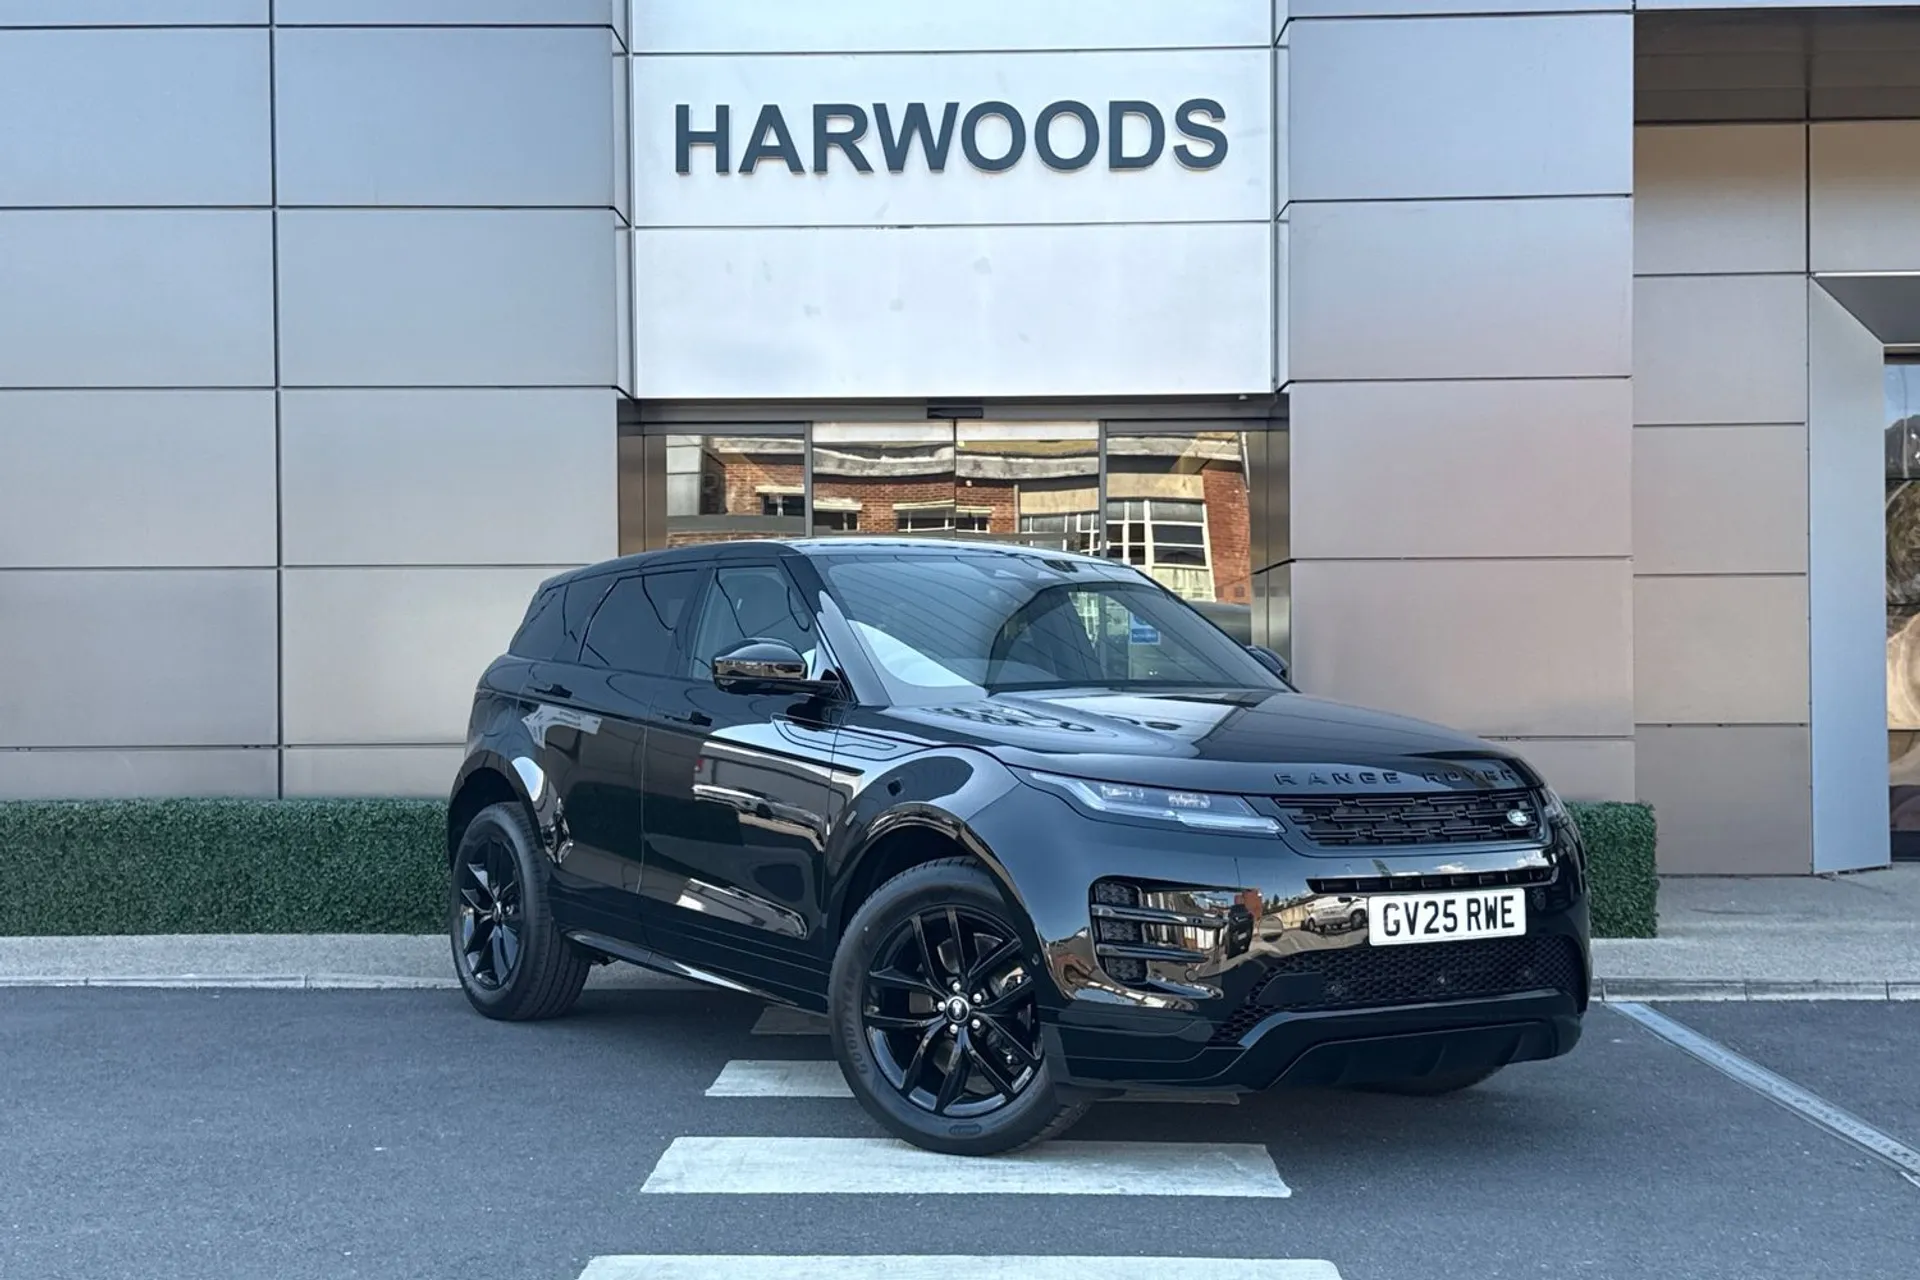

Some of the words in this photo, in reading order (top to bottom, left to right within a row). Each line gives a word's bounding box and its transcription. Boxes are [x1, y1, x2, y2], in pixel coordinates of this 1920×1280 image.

[675, 98, 1229, 175] HARWOODS
[1273, 771, 1401, 786] RANGE
[1421, 768, 1517, 783] ROVER
[1382, 899, 1458, 937] GV25
[1466, 895, 1515, 932] RWE
